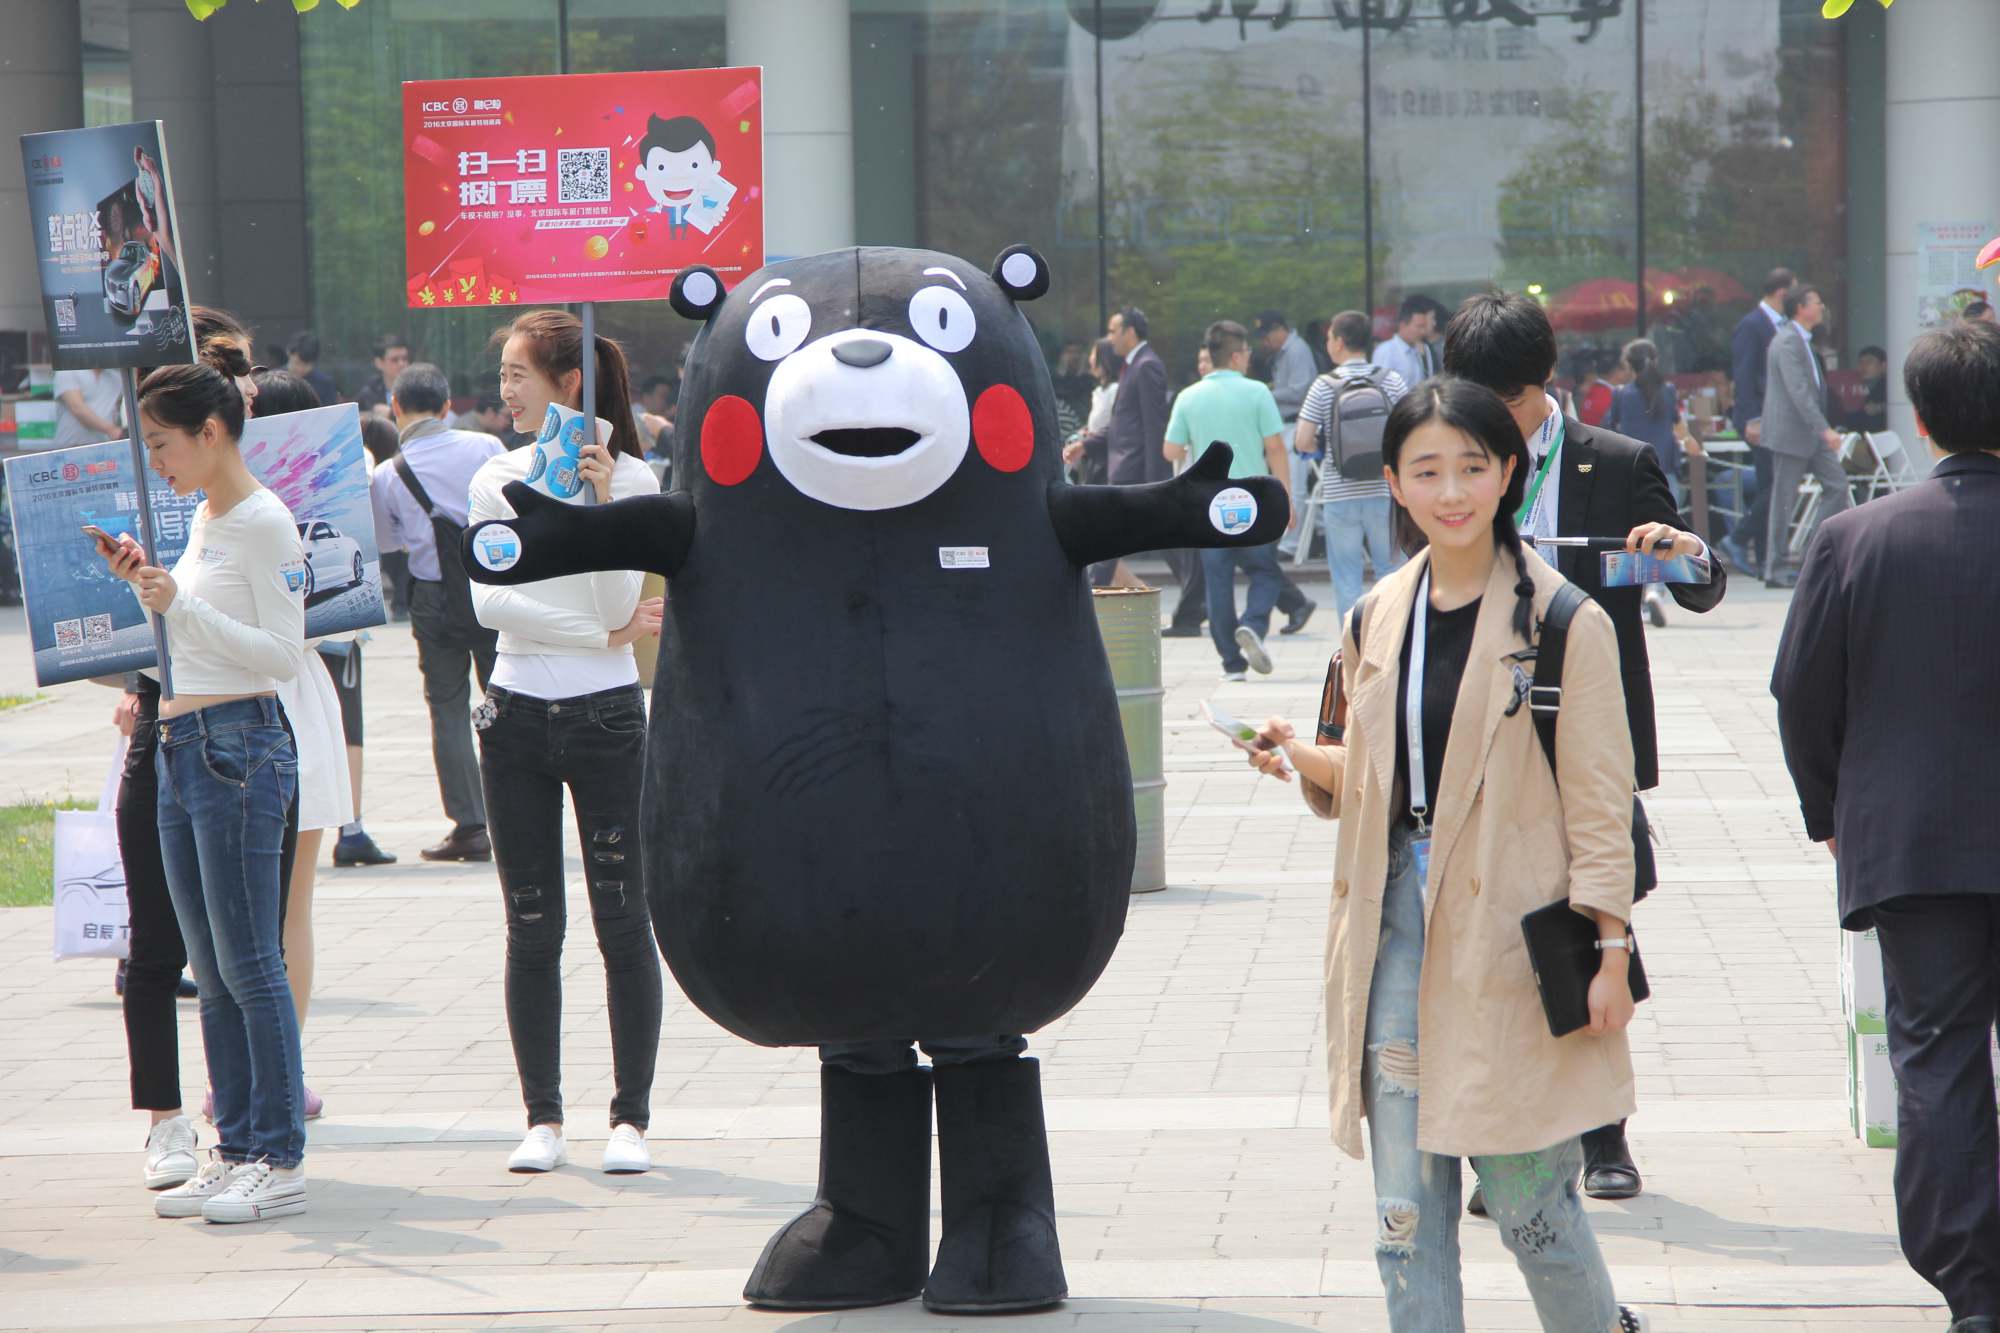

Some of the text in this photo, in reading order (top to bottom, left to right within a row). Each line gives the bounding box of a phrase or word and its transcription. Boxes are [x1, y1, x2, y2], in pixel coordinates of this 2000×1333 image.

[422, 101, 449, 112] ICBC
[457, 149, 547, 176] 扫一扫
[458, 178, 548, 206] 报门票
[29, 469, 59, 484] ICBC
[83, 923, 115, 939] 启辰
